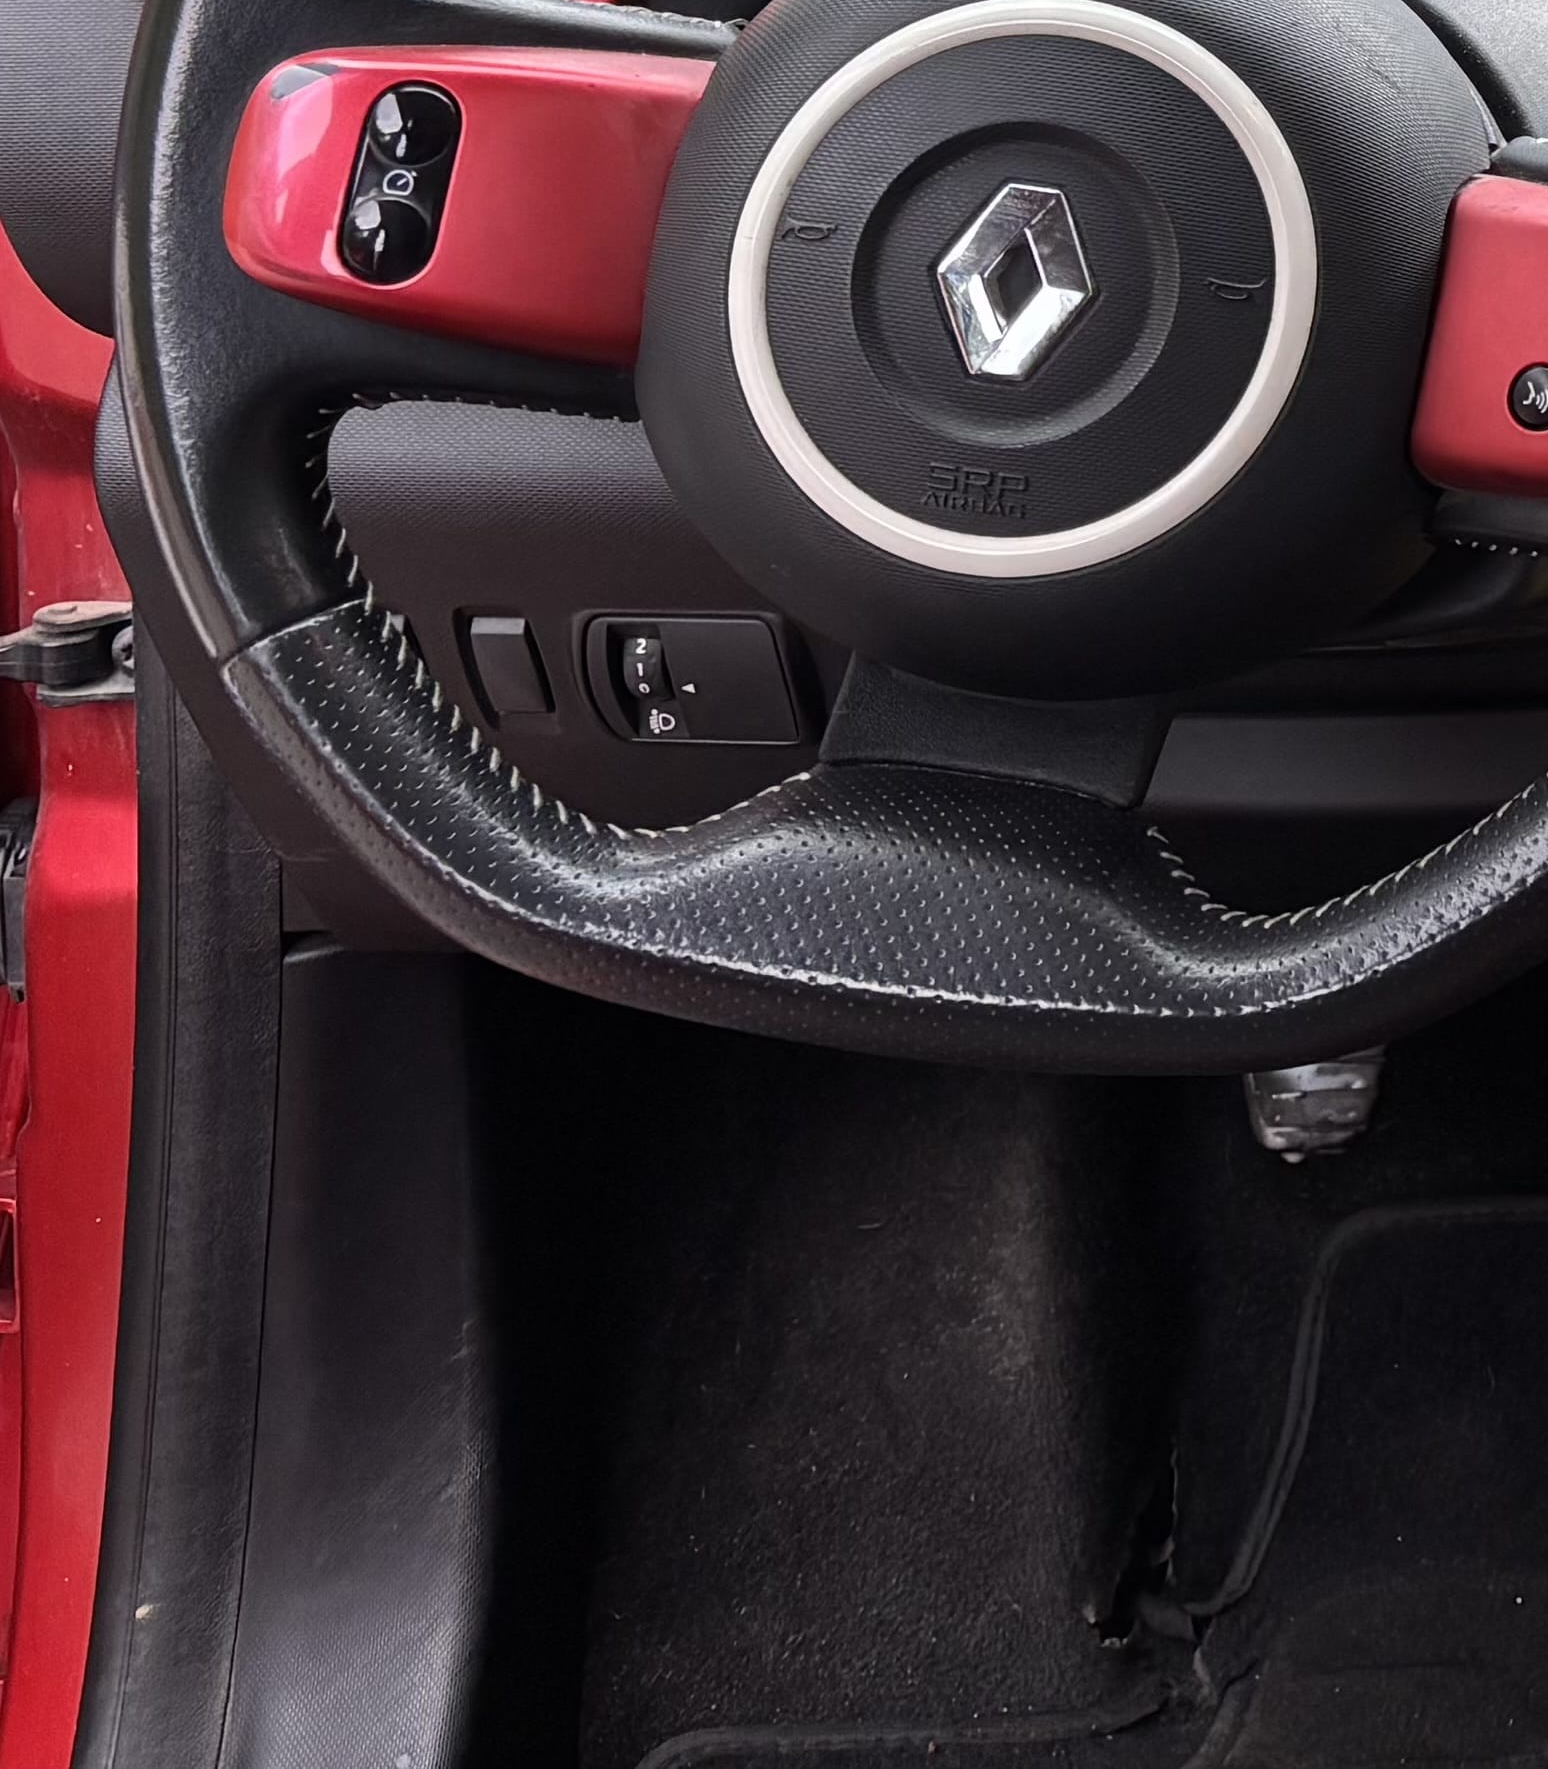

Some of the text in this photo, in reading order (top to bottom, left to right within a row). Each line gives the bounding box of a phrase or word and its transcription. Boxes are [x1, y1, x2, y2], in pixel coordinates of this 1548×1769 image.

[635, 637, 647, 655] 2
[636, 662, 644, 678] 1
[638, 682, 650, 694] 0
